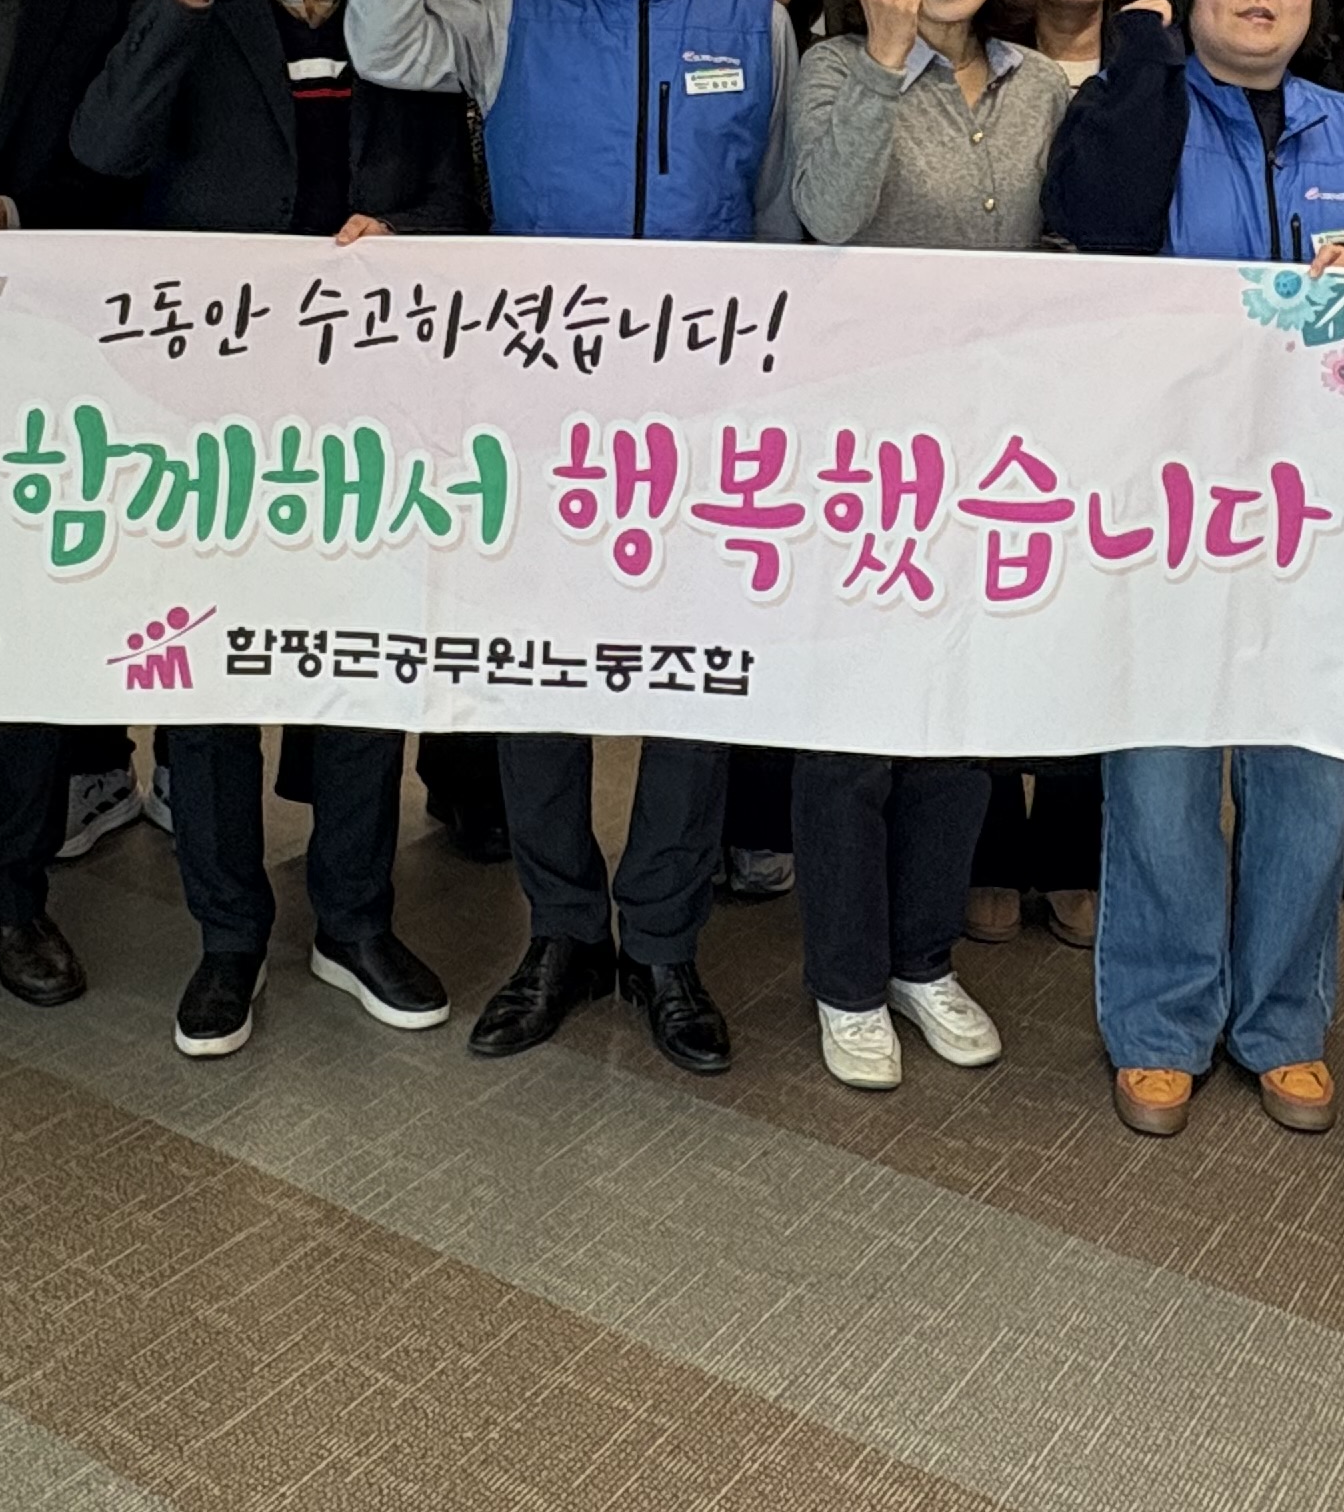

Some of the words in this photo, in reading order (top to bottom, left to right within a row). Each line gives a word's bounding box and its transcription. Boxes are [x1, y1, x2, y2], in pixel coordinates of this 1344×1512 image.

[97, 279, 270, 360] 그동안
[297, 277, 789, 376] 수고하셨습니다!
[0, 404, 507, 567] 함께해서
[553, 422, 1333, 602] 행복했습니다
[225, 626, 755, 697] 함평군공무원노동조합
